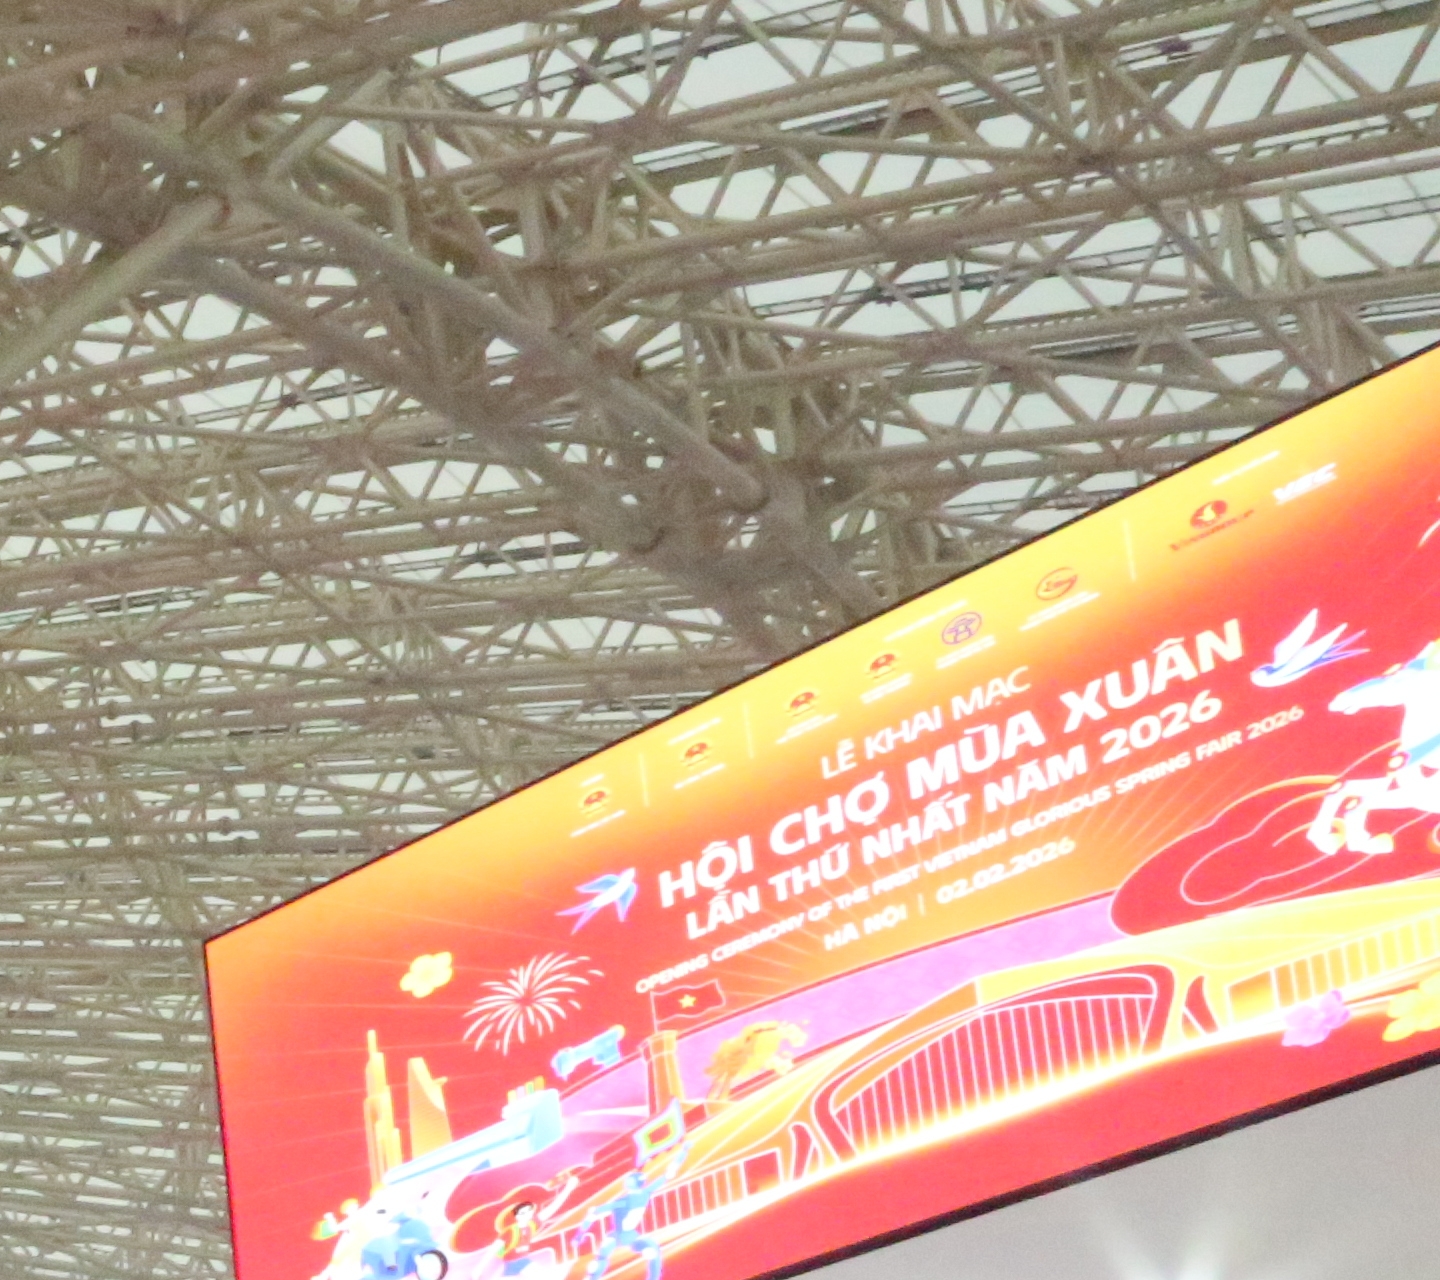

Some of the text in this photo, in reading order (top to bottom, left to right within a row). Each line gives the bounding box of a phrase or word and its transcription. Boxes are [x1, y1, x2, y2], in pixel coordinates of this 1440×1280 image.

[658, 835, 754, 907] HỘI
[770, 771, 890, 855] CHỢ
[906, 710, 1046, 799] MÙA
[1059, 618, 1244, 733] XUÂN
[685, 690, 1222, 940] LẦN THỨ NHẤT NĂM 2026
[822, 737, 857, 779] LỄ
[865, 704, 942, 760] KHAI
[952, 665, 1031, 721] MẠC
[635, 705, 1305, 994] OPENING CEREMONY OF THE FIRST VIETNAM GLORIOUS SPRING FAIR 2026
[936, 836, 1076, 905] 02.02.2026
